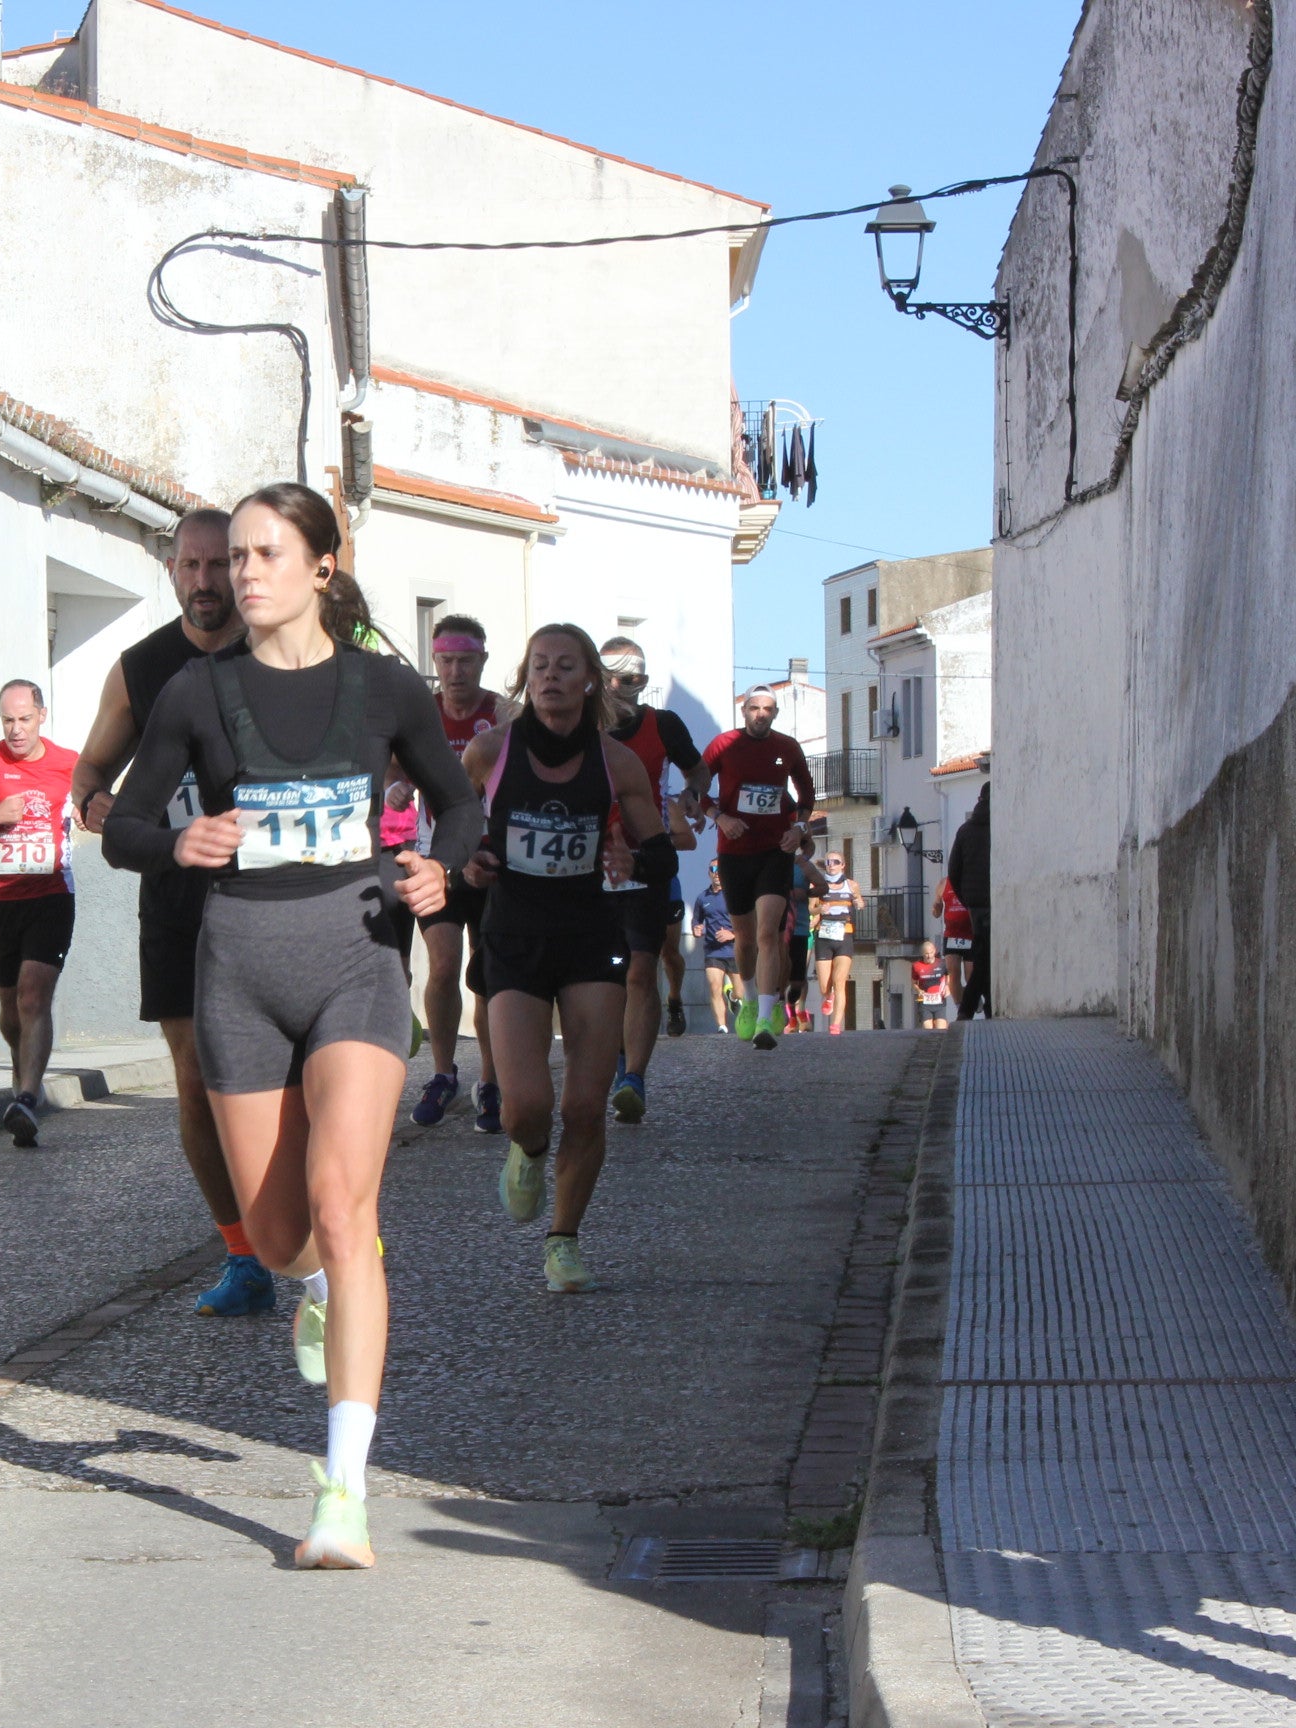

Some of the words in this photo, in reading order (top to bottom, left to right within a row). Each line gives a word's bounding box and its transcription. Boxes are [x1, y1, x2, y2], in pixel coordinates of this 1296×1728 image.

[746, 792, 778, 807] 162
[258, 806, 355, 848] 117
[0, 843, 47, 864] 210
[520, 830, 588, 862] 146
